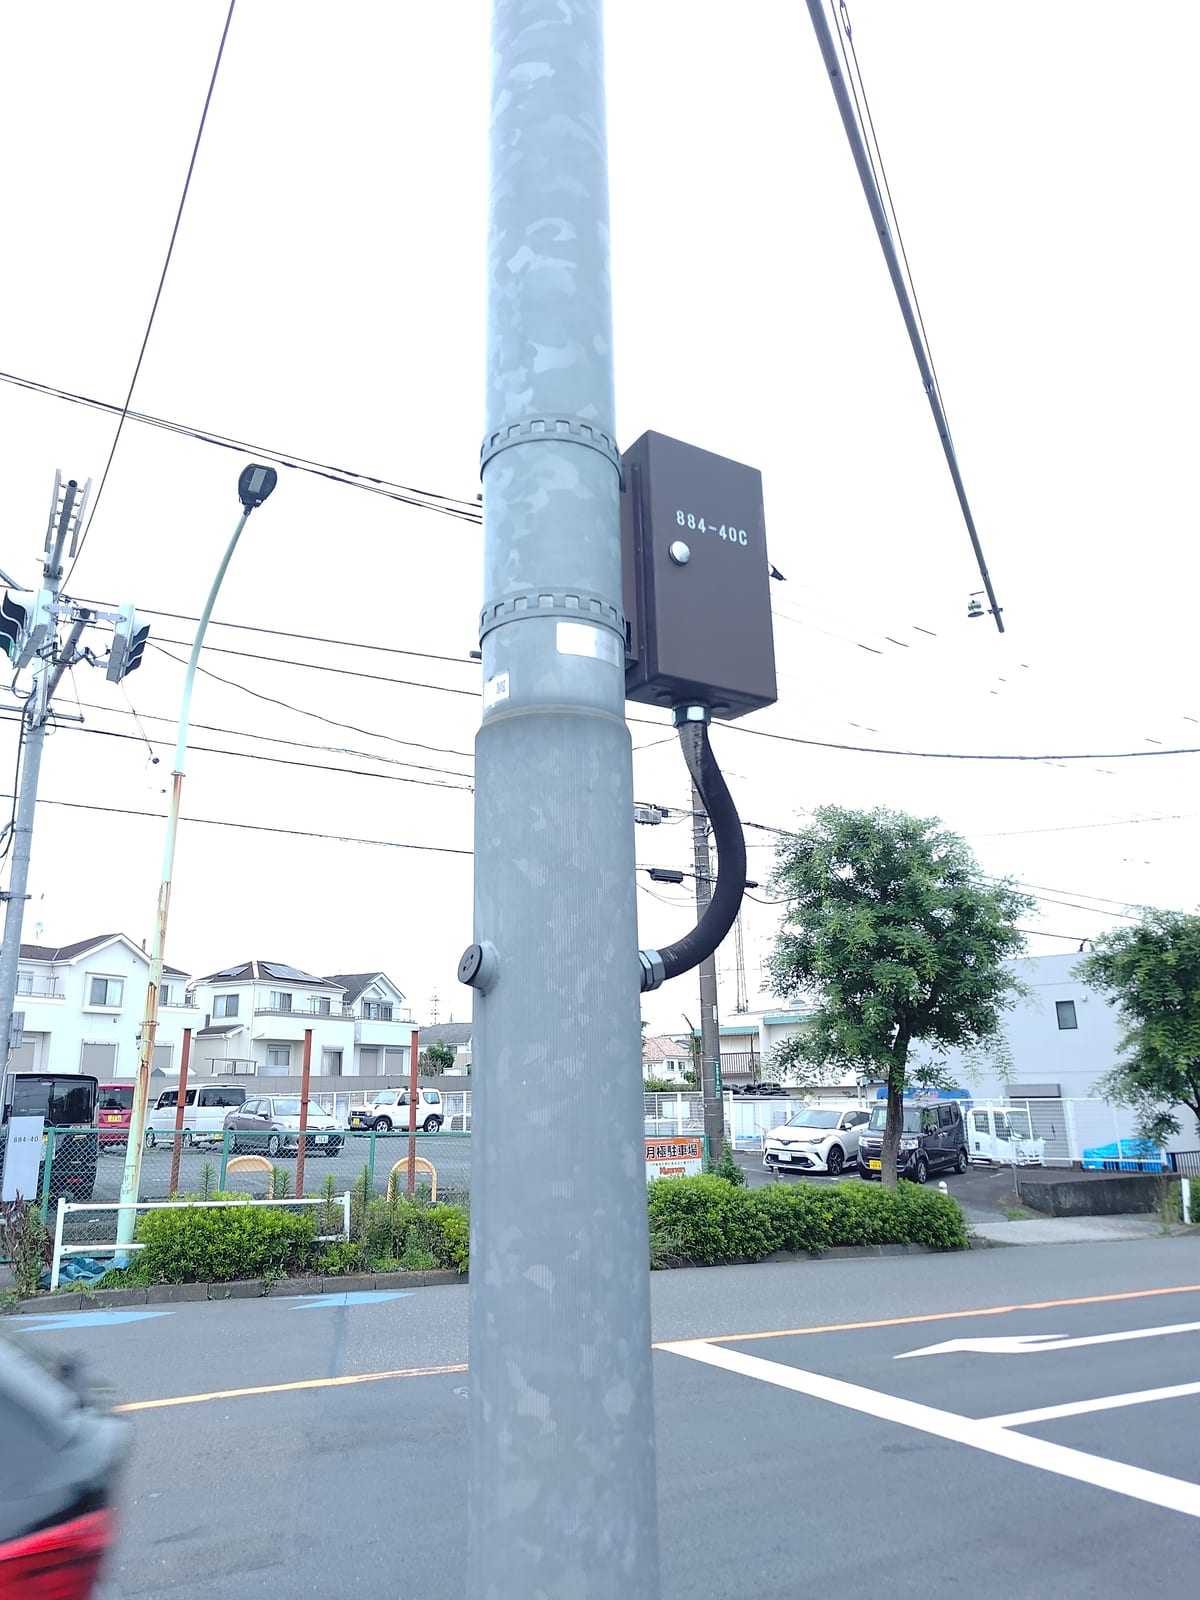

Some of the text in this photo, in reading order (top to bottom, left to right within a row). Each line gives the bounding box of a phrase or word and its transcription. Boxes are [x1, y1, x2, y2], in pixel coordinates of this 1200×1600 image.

[676, 509, 748, 546] 884-40C
[646, 1144, 698, 1159] 月極駐車場
